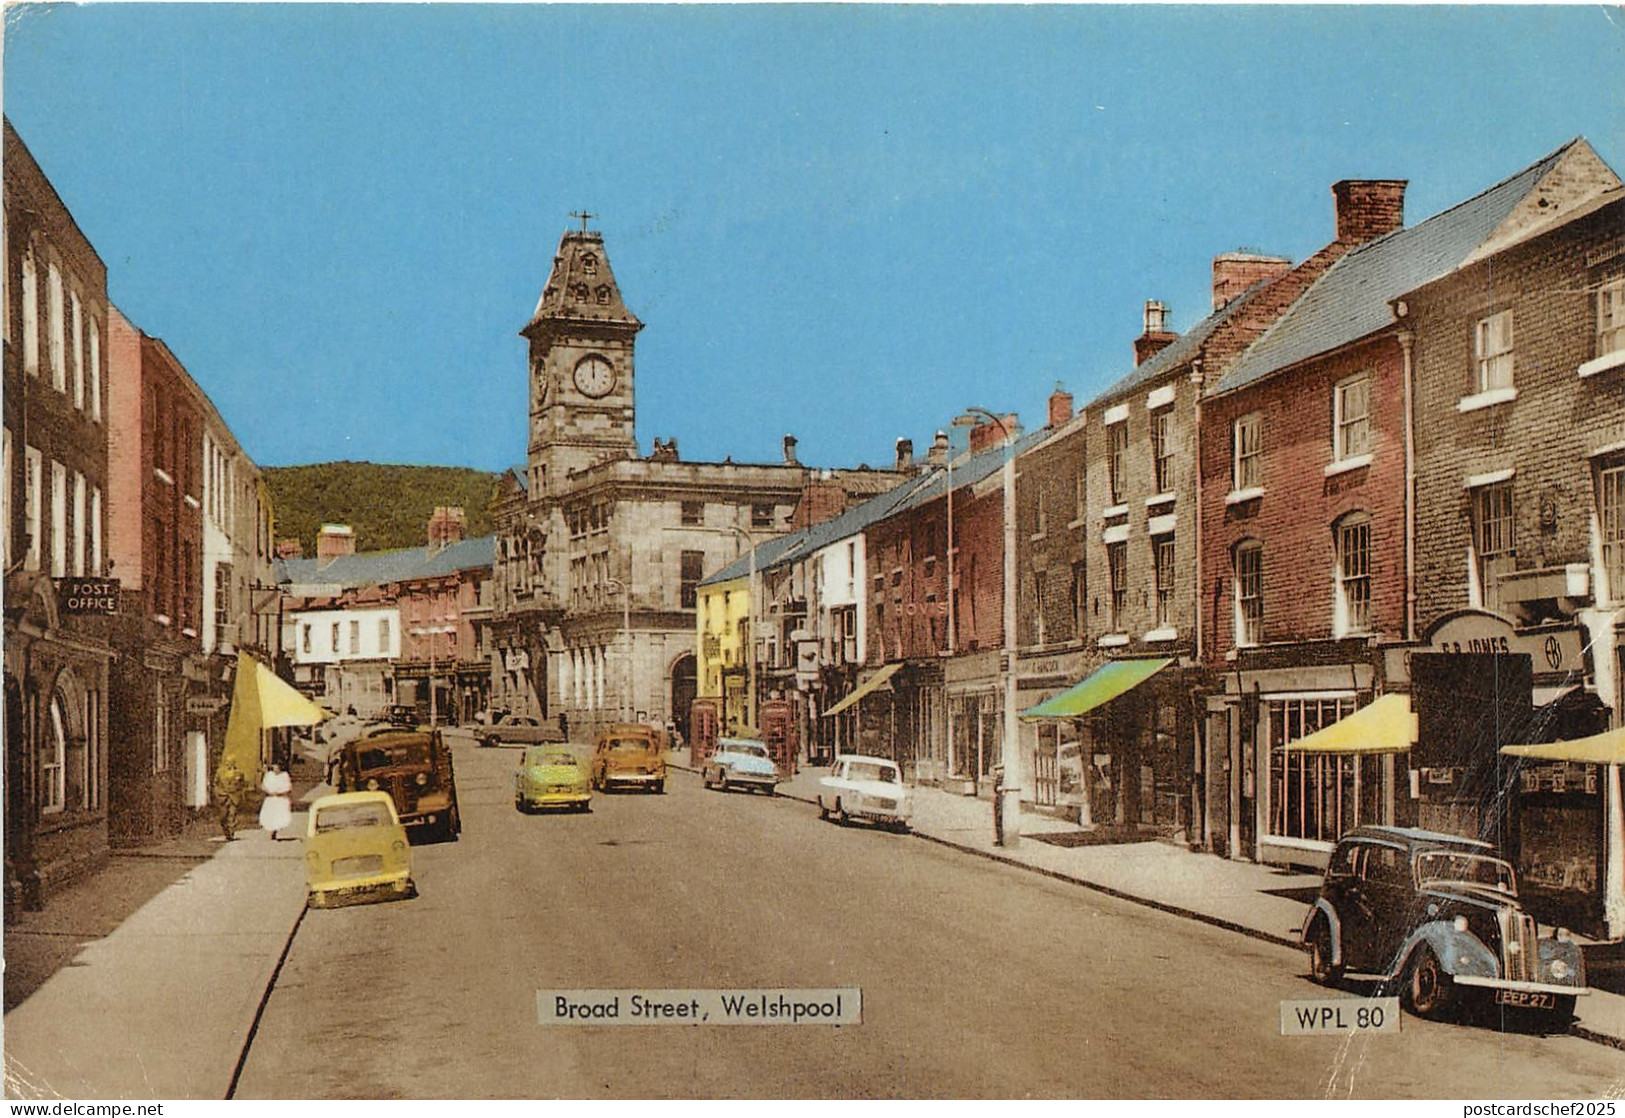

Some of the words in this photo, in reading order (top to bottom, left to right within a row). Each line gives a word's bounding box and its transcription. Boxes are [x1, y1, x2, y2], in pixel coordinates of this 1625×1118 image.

[73, 583, 110, 596] POST
[67, 597, 115, 610] OFFICE
[1530, 994, 1548, 1007] 27
